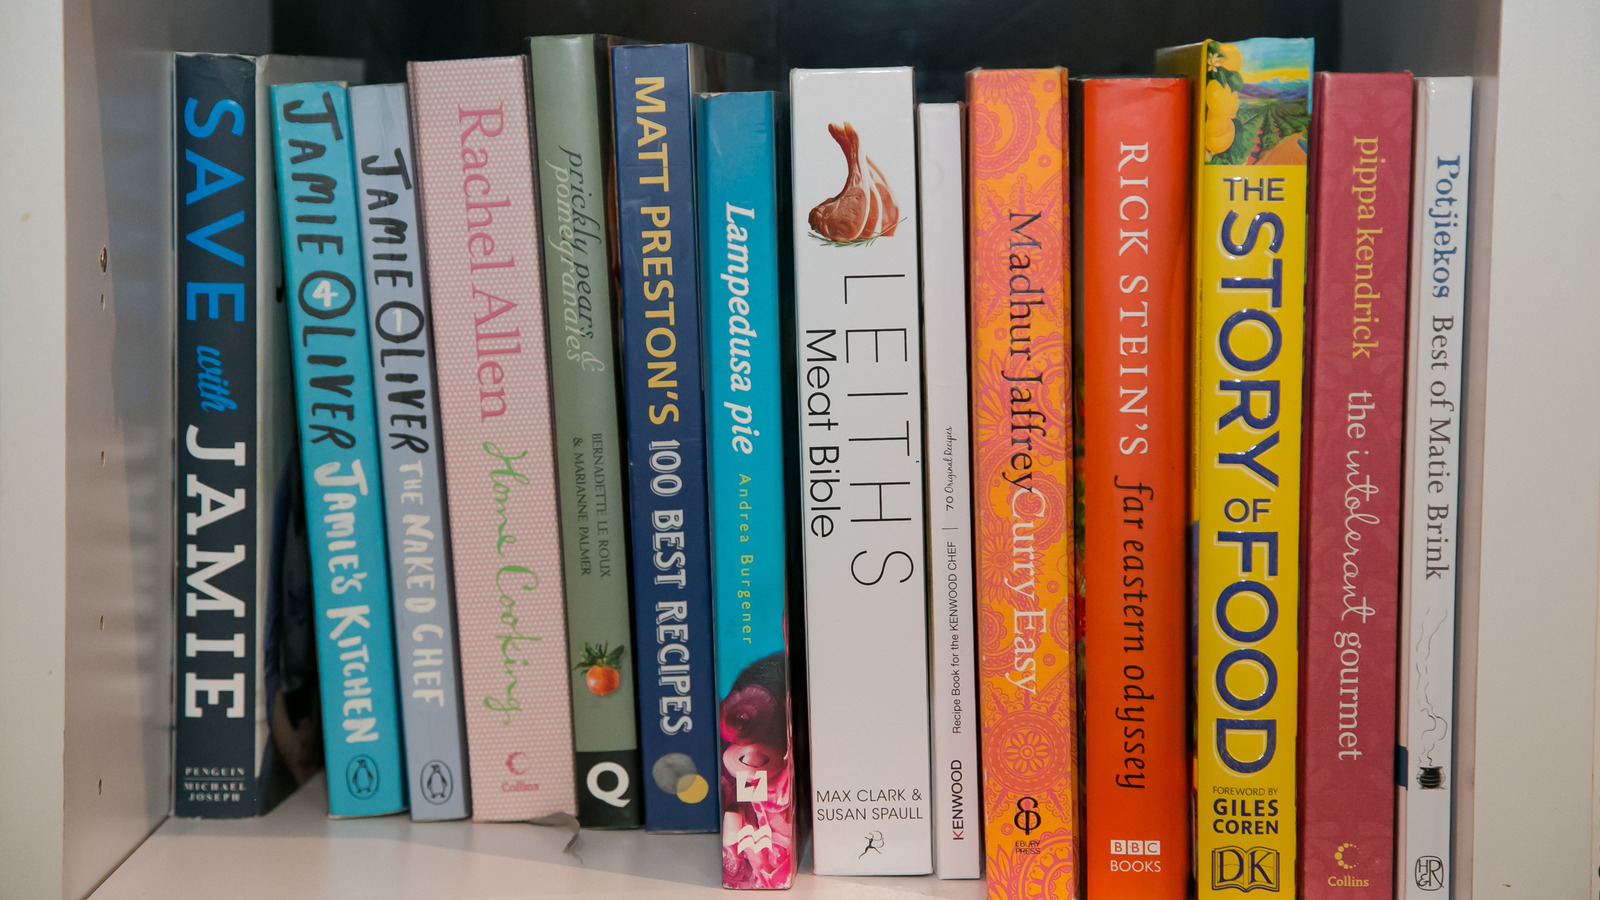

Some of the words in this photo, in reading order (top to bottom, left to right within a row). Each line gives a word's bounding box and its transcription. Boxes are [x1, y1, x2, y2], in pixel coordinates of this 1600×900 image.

[283, 91, 343, 255] JAMIE
[634, 76, 670, 192] MATT
[184, 96, 246, 322] SAVE
[360, 147, 412, 288] JAMIE
[457, 101, 516, 275] Rachel
[558, 145, 602, 255] prickly
[1118, 141, 1149, 257] RICK
[1223, 177, 1286, 202] THE
[1353, 136, 1386, 221] pippa
[545, 159, 587, 362] pomegranates
[1428, 154, 1461, 299] Potjiekos
[566, 257, 594, 339] pears
[640, 205, 680, 425] PRESTON'S
[720, 201, 758, 392] Lampedusa
[1009, 209, 1045, 361] Madhur
[1352, 226, 1383, 360] kendrick
[196, 345, 238, 413] with
[298, 270, 356, 449] OLIVER
[375, 300, 430, 454] OLIVER
[471, 281, 522, 423] Allen
[806, 329, 839, 431] Meat
[1119, 274, 1149, 455] STEIN'S
[1216, 209, 1285, 490] STORY
[1431, 315, 1455, 371] Best
[724, 401, 760, 455] pie
[844, 274, 914, 586] LEITHS
[1001, 370, 1047, 494] Jaffrey
[1346, 389, 1376, 440] the
[1430, 380, 1455, 409] of
[573, 437, 584, 448] &
[592, 433, 607, 516] BERNADETTE
[648, 439, 683, 496] 100
[943, 457, 957, 493] Original
[944, 426, 957, 456] Recipes
[1427, 415, 1454, 495] Matie
[398, 459, 424, 506] THE
[482, 440, 530, 557] Home
[574, 452, 588, 523] MARIANNE
[738, 473, 752, 543] Andrea
[809, 446, 841, 538] Bible
[946, 496, 954, 511] 70
[1115, 475, 1154, 530] far
[1224, 498, 1271, 523] OF
[313, 458, 369, 595] JAMIE'S
[401, 513, 437, 614] NAKED
[579, 526, 592, 576] PALMER
[597, 521, 608, 536] LE
[598, 540, 611, 578] ROUX
[651, 509, 686, 589] BEST
[947, 541, 957, 571] CHEF
[1005, 487, 1046, 610] Curry
[1342, 450, 1380, 624] intolerant
[1425, 503, 1450, 580] Brink
[185, 423, 246, 719] JAMIE
[737, 554, 754, 645] Burgener
[948, 573, 959, 631] KENWOOD
[1123, 540, 1150, 653] eastern
[326, 604, 379, 744] KITCHEN
[411, 623, 445, 708] CHEF
[484, 564, 542, 725] Cooking
[655, 600, 693, 736] RECIPES
[950, 634, 960, 651] the
[951, 653, 960, 667] for
[951, 669, 961, 697] Book
[1005, 607, 1046, 695] Easy
[1213, 530, 1279, 776] FOOD
[952, 699, 964, 734] Recipe
[1115, 664, 1154, 789] odyssey
[1334, 631, 1362, 761] gourmet
[184, 766, 245, 776] PENGUIN
[184, 782, 247, 791] MICHAEL
[189, 792, 240, 802] JOSEPH
[586, 762, 631, 808] Q
[816, 790, 851, 802] MAX
[857, 789, 906, 802] CLARK
[911, 788, 923, 801] &
[952, 758, 965, 842] KENWOOD
[1213, 786, 1266, 796] FOREWORD
[1268, 788, 1278, 796] BY
[1213, 798, 1279, 817] GILES
[817, 808, 866, 821] SUSAN
[872, 807, 923, 820] SPAULL
[1110, 840, 1160, 855] BBC
[1212, 819, 1279, 835] COREN
[1110, 860, 1161, 873] BOOKS
[1217, 849, 1275, 885] DK
[1327, 876, 1369, 888] Collins
